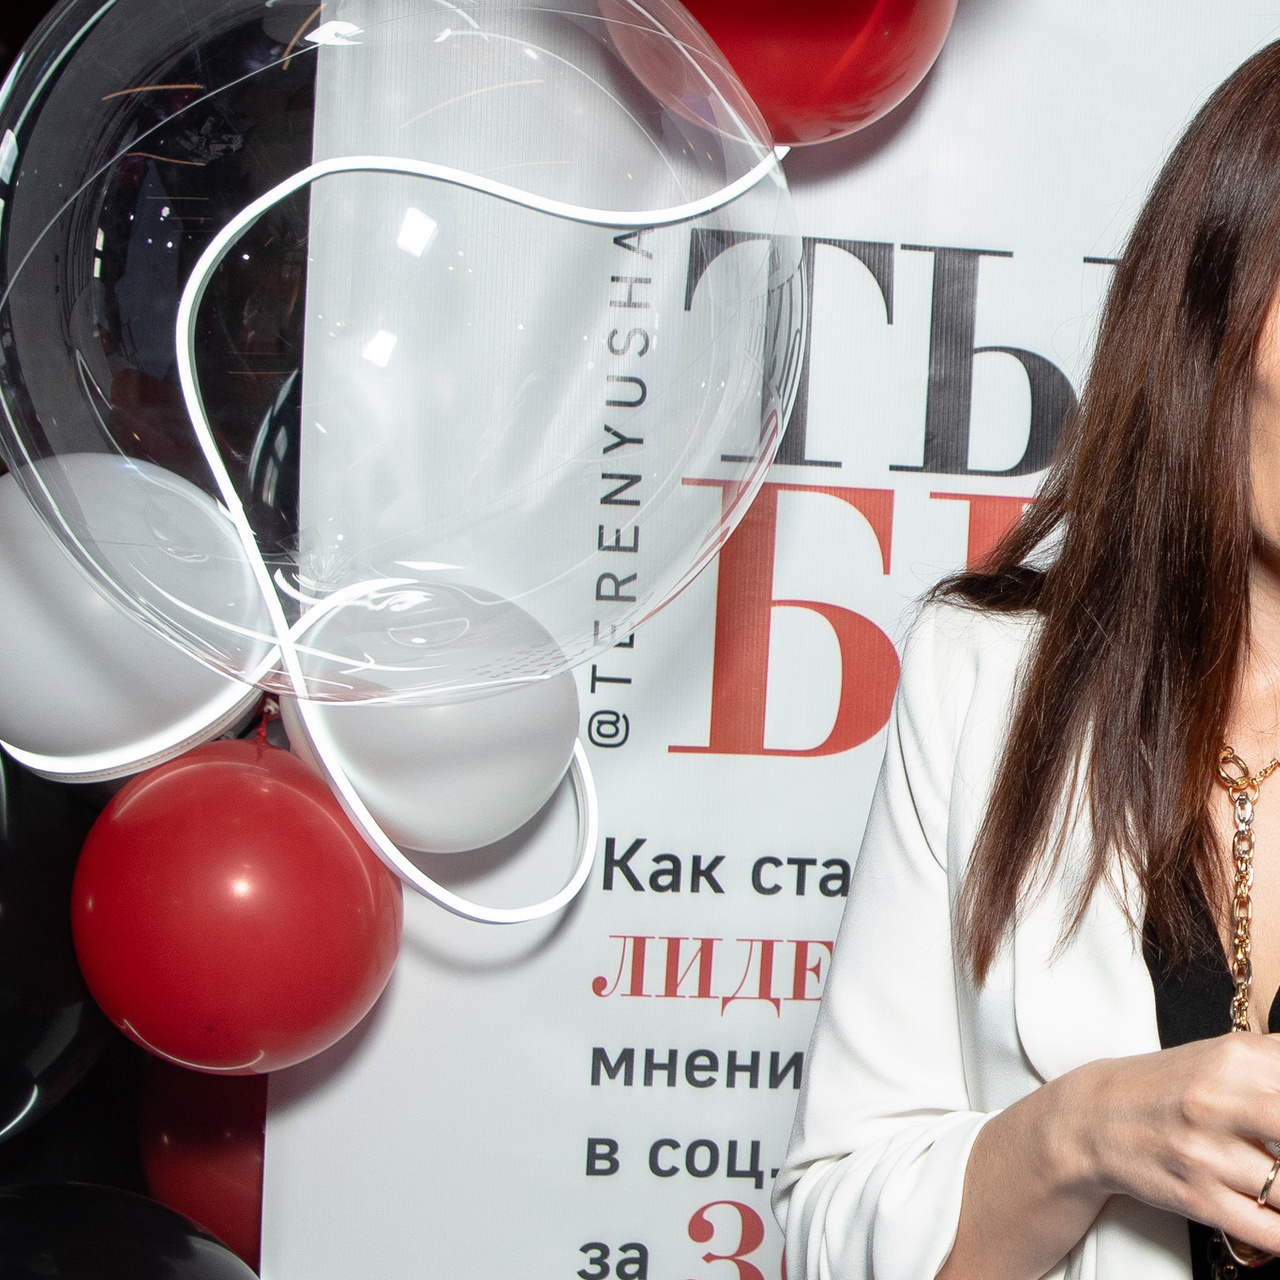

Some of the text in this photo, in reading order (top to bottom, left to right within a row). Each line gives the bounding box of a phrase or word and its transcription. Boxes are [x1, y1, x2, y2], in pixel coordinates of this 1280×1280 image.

[587, 226, 655, 749] @TERENYUSHA
[602, 836, 852, 898] Как ста
[590, 934, 835, 1018] ЛИДЕ
[590, 1046, 804, 1090] мнени
[585, 1138, 620, 1177] в
